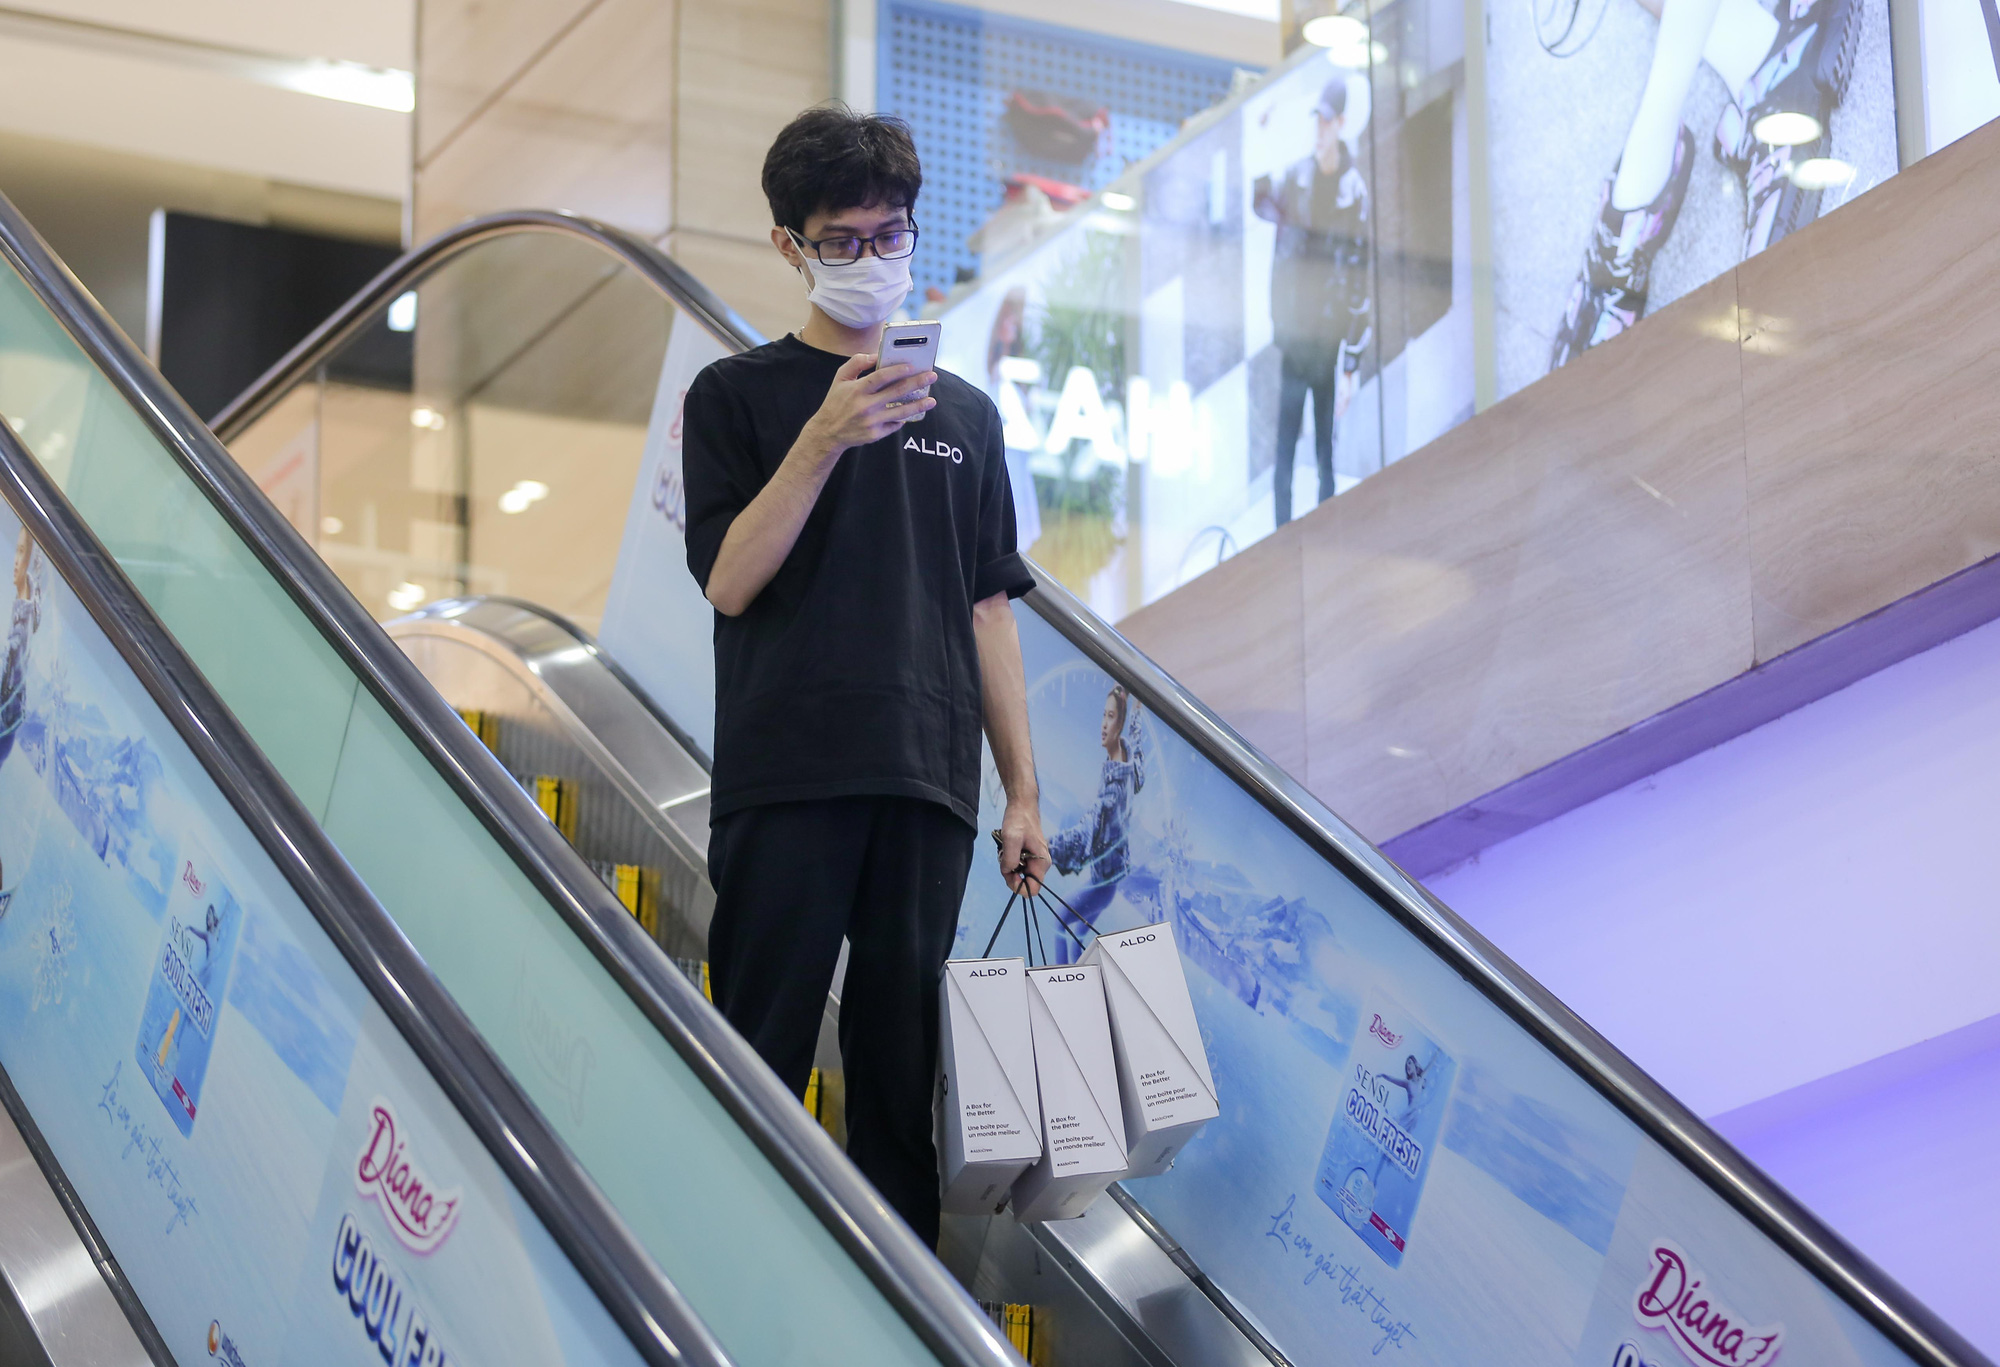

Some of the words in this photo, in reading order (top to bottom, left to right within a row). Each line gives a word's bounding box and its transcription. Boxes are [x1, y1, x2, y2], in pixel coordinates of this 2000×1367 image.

[903, 436, 963, 465] ALDO
[170, 915, 194, 961] SENSI
[1120, 933, 1156, 948] ALDO
[162, 942, 185, 995] COOL
[184, 973, 213, 1035] FRESH
[969, 968, 1008, 978] ALDO
[1048, 973, 1085, 983] ALDO
[1369, 1013, 1399, 1045] Diana
[1152, 1076, 1170, 1084] Better
[1173, 1087, 1186, 1095] pour
[1355, 1063, 1389, 1107] SENSI
[1155, 1097, 1175, 1106] monde
[1176, 1092, 1197, 1100] meilleur
[1063, 1143, 1083, 1151] monde
[1346, 1088, 1379, 1138] COOL
[1378, 1117, 1421, 1175] FRESH
[360, 1106, 440, 1237] Diana
[1265, 1193, 1296, 1253] Là
[1294, 1235, 1313, 1258] con
[1303, 1253, 1338, 1286] gái
[333, 1212, 402, 1367] COOL
[1638, 1247, 1752, 1367] Diana
